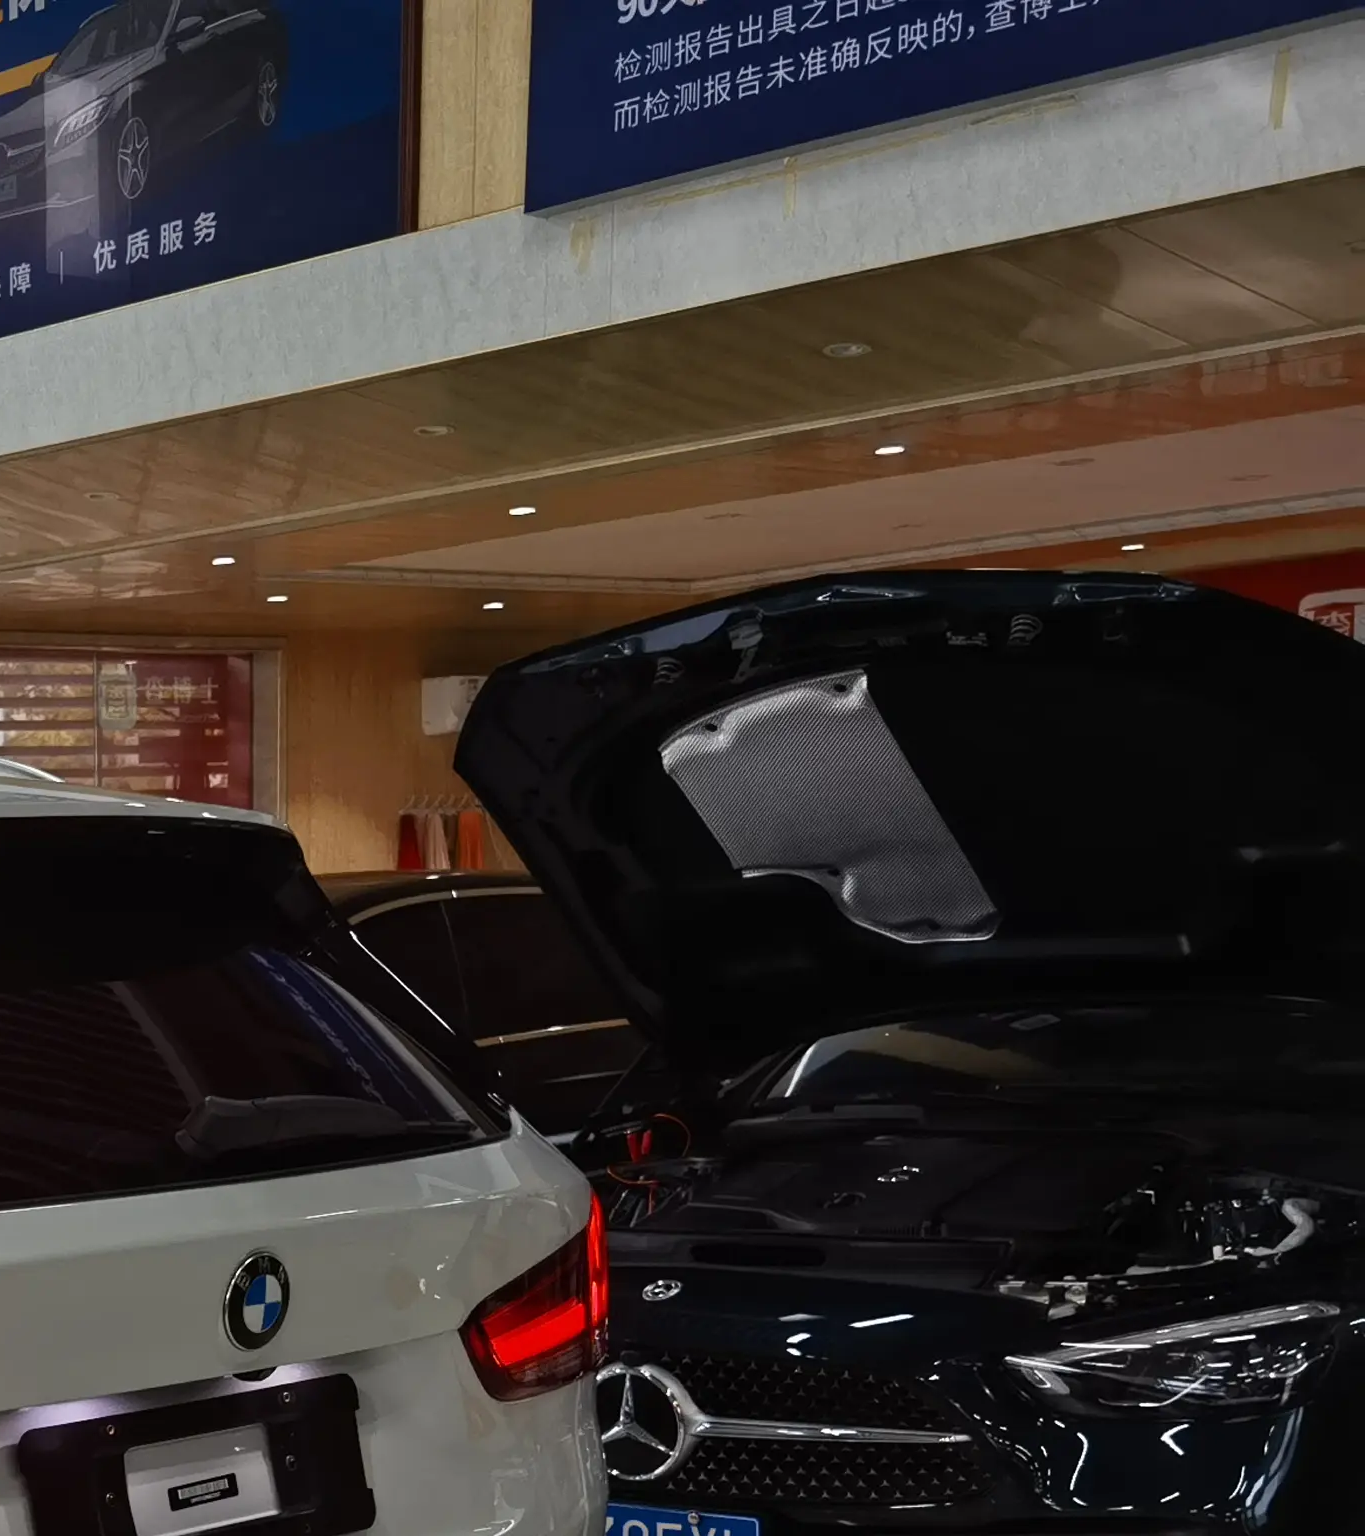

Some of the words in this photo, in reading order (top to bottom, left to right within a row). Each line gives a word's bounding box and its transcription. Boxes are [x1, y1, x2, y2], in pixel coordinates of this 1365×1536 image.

[92, 211, 218, 275] 优质服务
[236, 1257, 286, 1291] BMW
